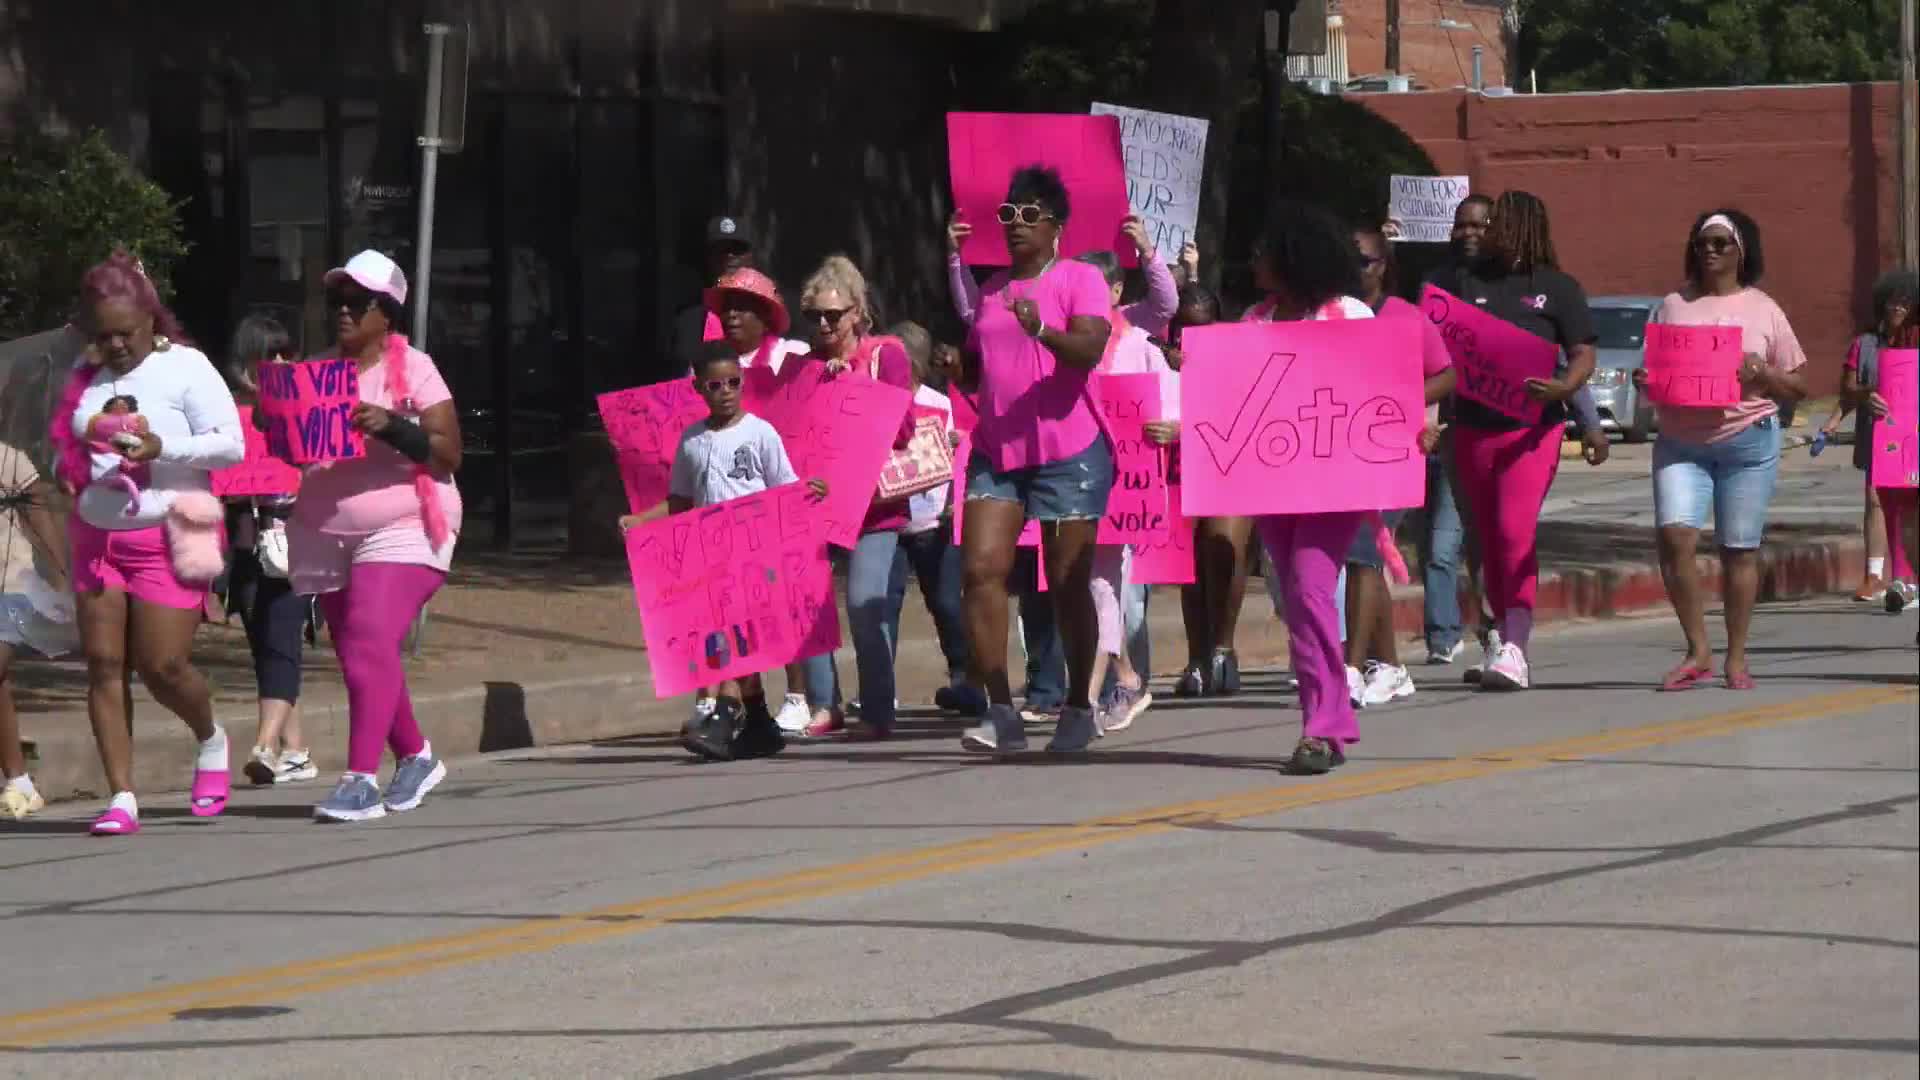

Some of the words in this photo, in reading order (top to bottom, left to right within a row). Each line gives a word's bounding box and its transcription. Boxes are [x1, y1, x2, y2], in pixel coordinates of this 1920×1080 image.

[1119, 114, 1203, 163] EMOCRACY
[1125, 148, 1184, 184] EEDS
[1398, 177, 1424, 197] VOTE
[1432, 179, 1457, 201] FOR
[306, 361, 356, 396] VOTE
[1195, 353, 1410, 476] Vote
[1109, 500, 1164, 532] vote
[640, 494, 811, 580] VOTE
